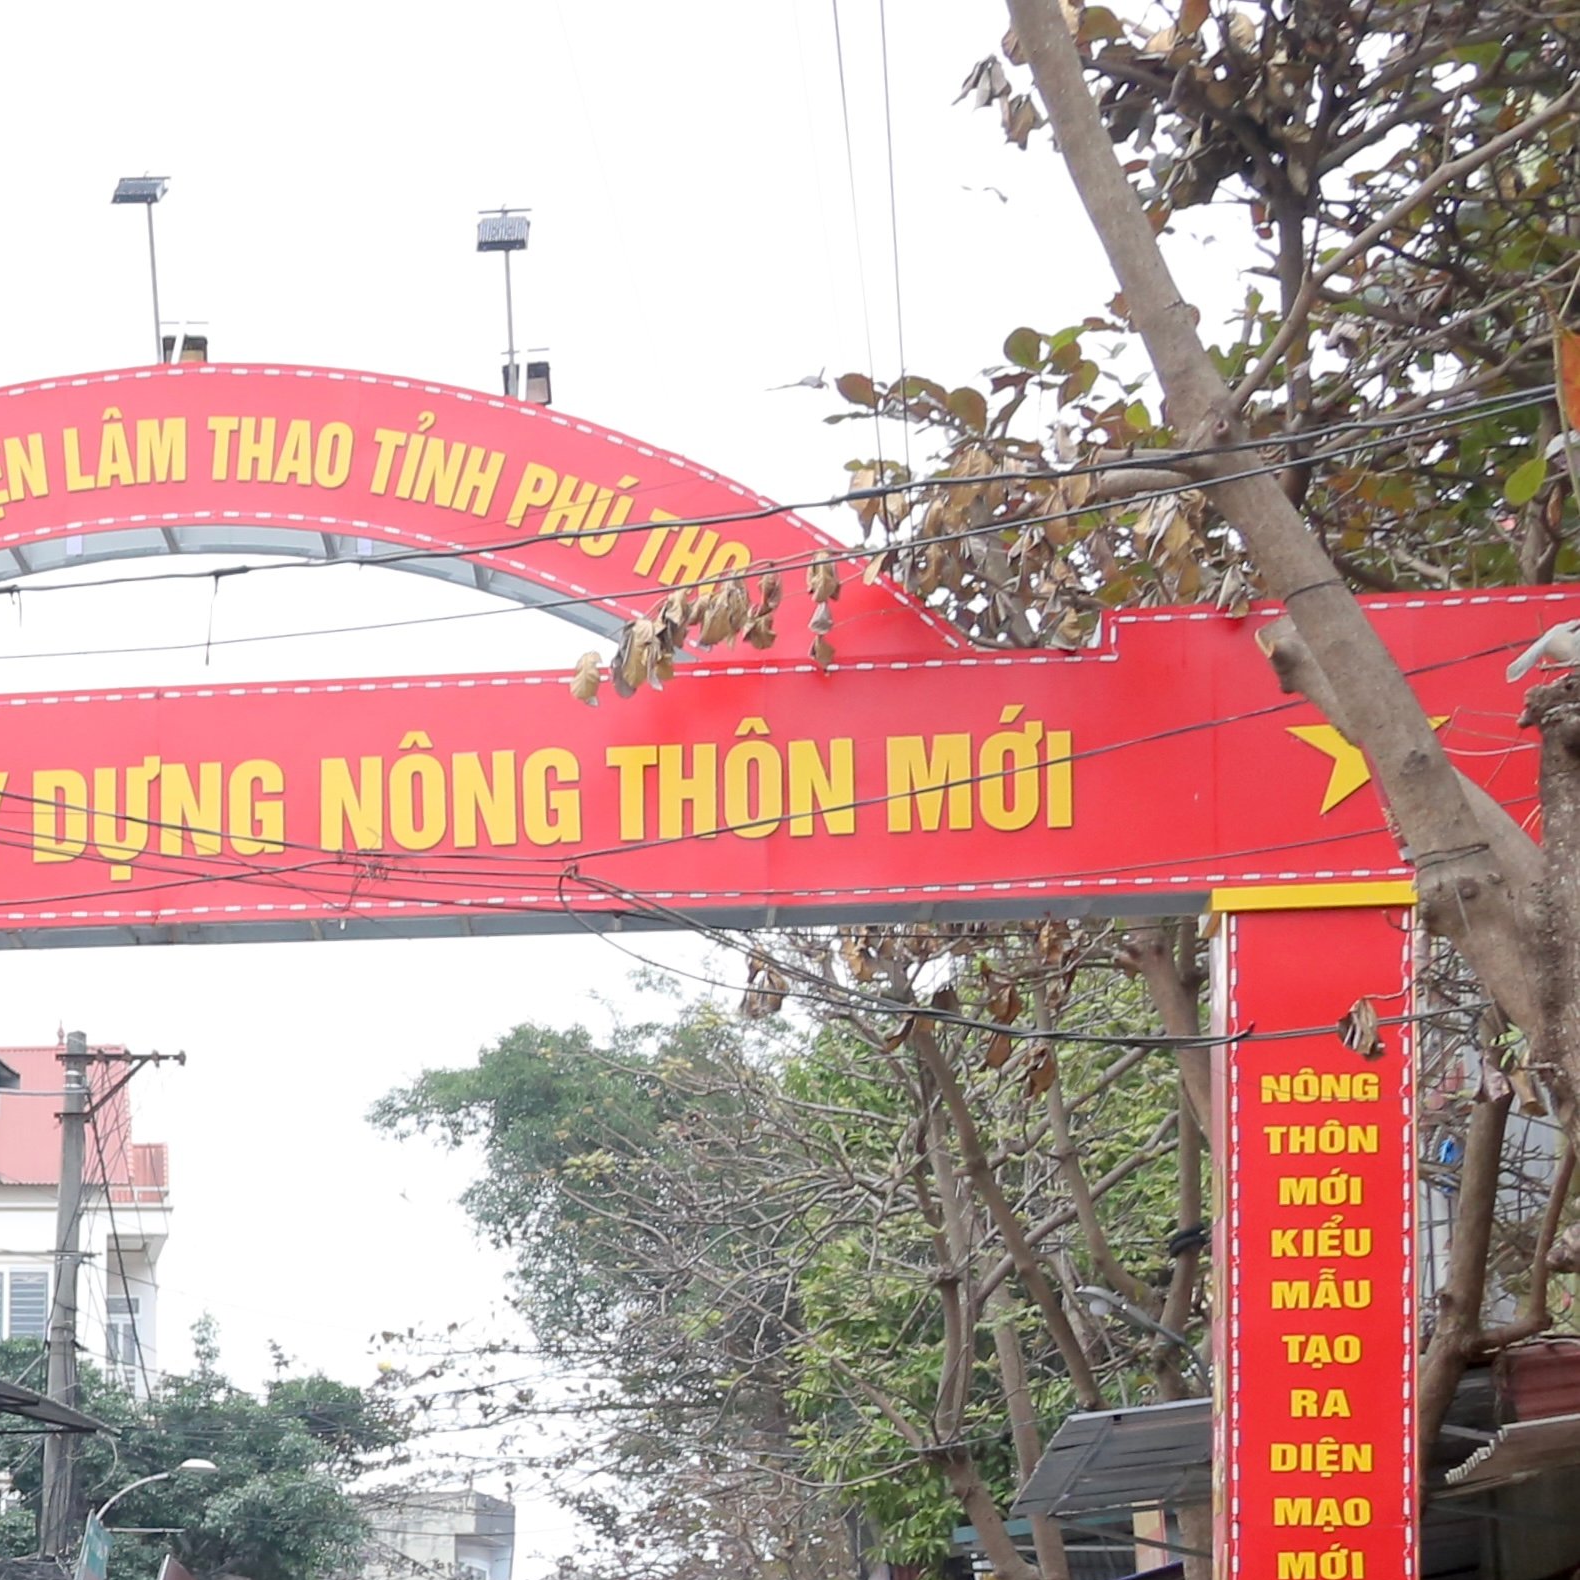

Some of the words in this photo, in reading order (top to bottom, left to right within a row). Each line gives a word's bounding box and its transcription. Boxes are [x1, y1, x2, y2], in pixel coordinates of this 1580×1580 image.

[64, 408, 188, 491] LÂM
[208, 417, 354, 489] THAO
[372, 413, 507, 518] TỈNH
[505, 461, 640, 558] PHÚ
[32, 756, 285, 881] DỰNG
[320, 731, 582, 851] NÔNG
[606, 717, 855, 841] THÔN
[886, 704, 1074, 833] MỚI
[1261, 1067, 1380, 1104] NÔNG
[1263, 1118, 1379, 1156] THÔN
[1278, 1166, 1363, 1206] MỚI
[1270, 1214, 1372, 1259] KIỂU
[1270, 1267, 1372, 1310] MẪU
[1281, 1334, 1362, 1370] TẠO
[1289, 1389, 1351, 1419] RA
[1269, 1436, 1373, 1478] DIỆN
[1273, 1497, 1372, 1532] MẠO
[1277, 1542, 1366, 1580] MỚI
